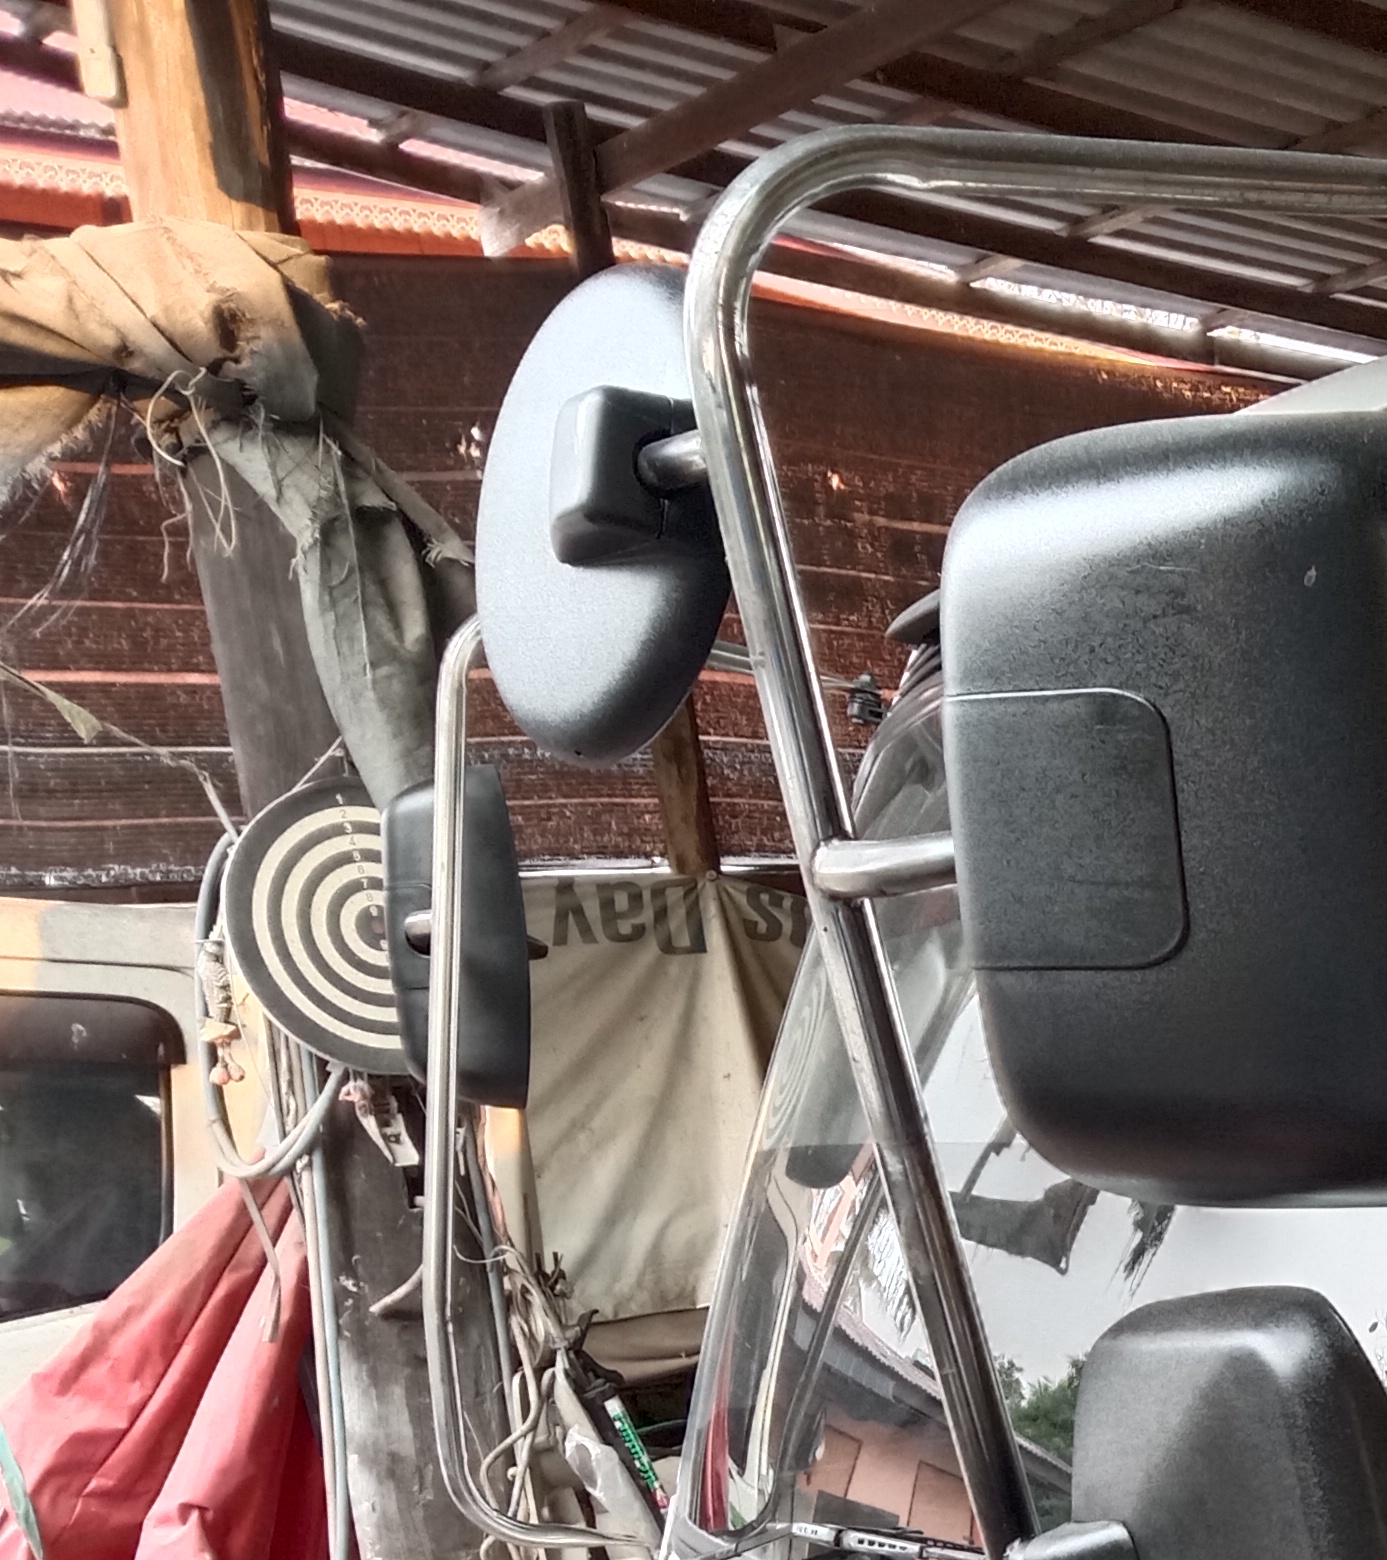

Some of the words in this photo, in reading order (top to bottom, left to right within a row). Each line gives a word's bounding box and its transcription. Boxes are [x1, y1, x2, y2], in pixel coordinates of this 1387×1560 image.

[335, 793, 344, 805] 1
[339, 809, 347, 819] 2
[342, 823, 353, 834] 3
[348, 836, 356, 846] 4
[352, 850, 361, 861] 5
[357, 865, 365, 875] 6
[360, 878, 369, 889] 7
[553, 877, 707, 955] Day
